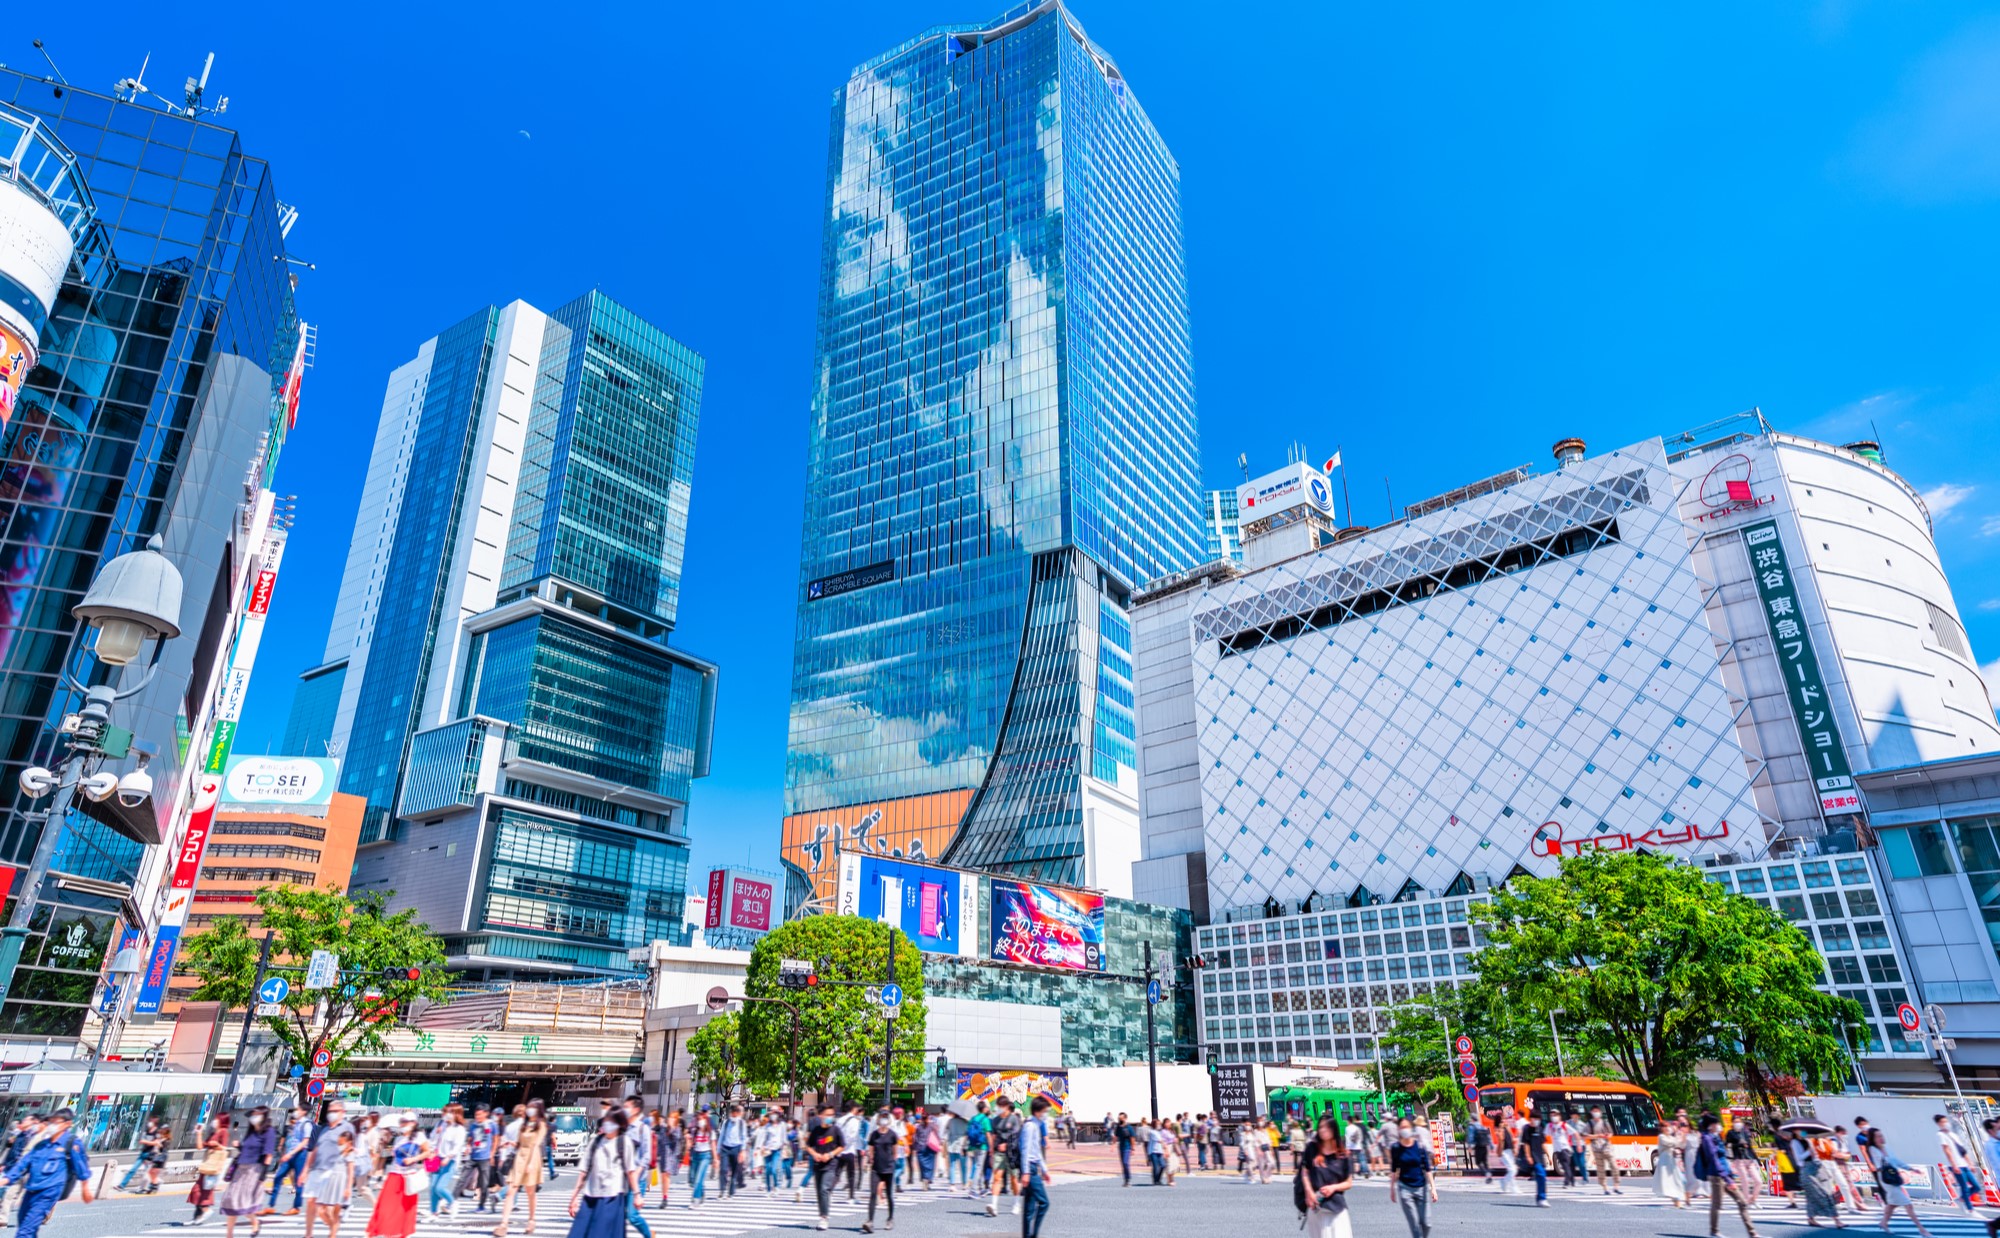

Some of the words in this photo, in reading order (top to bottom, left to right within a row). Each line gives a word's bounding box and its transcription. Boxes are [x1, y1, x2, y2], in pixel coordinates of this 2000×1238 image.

[1256, 483, 1302, 504] TOKYU
[1693, 495, 1775, 522] TOKYU
[824, 573, 855, 586] SHIBUYA
[824, 580, 861, 595] SCRAMBLE
[862, 570, 892, 585] SQUARE
[253, 581, 270, 612] アイフル
[1769, 596, 1833, 772] 東急フードショー
[1826, 778, 1841, 787] B1
[1823, 796, 1858, 809] 営業中
[182, 829, 204, 863] アコム
[1562, 820, 1729, 856] TOKYU
[176, 879, 190, 887] 3F
[734, 882, 771, 900] ほけんの
[709, 872, 720, 926] ほけんの窓口
[742, 899, 763, 914] 窓口
[736, 914, 765, 926] グループ
[1001, 916, 1076, 942] このままで、
[52, 945, 91, 958] COFFEE
[147, 940, 172, 988] PROMISE
[415, 1032, 540, 1053] 渋谷駅
[1217, 1069, 1247, 1079] 毎週土曜
[1219, 1088, 1248, 1097] アベマで
